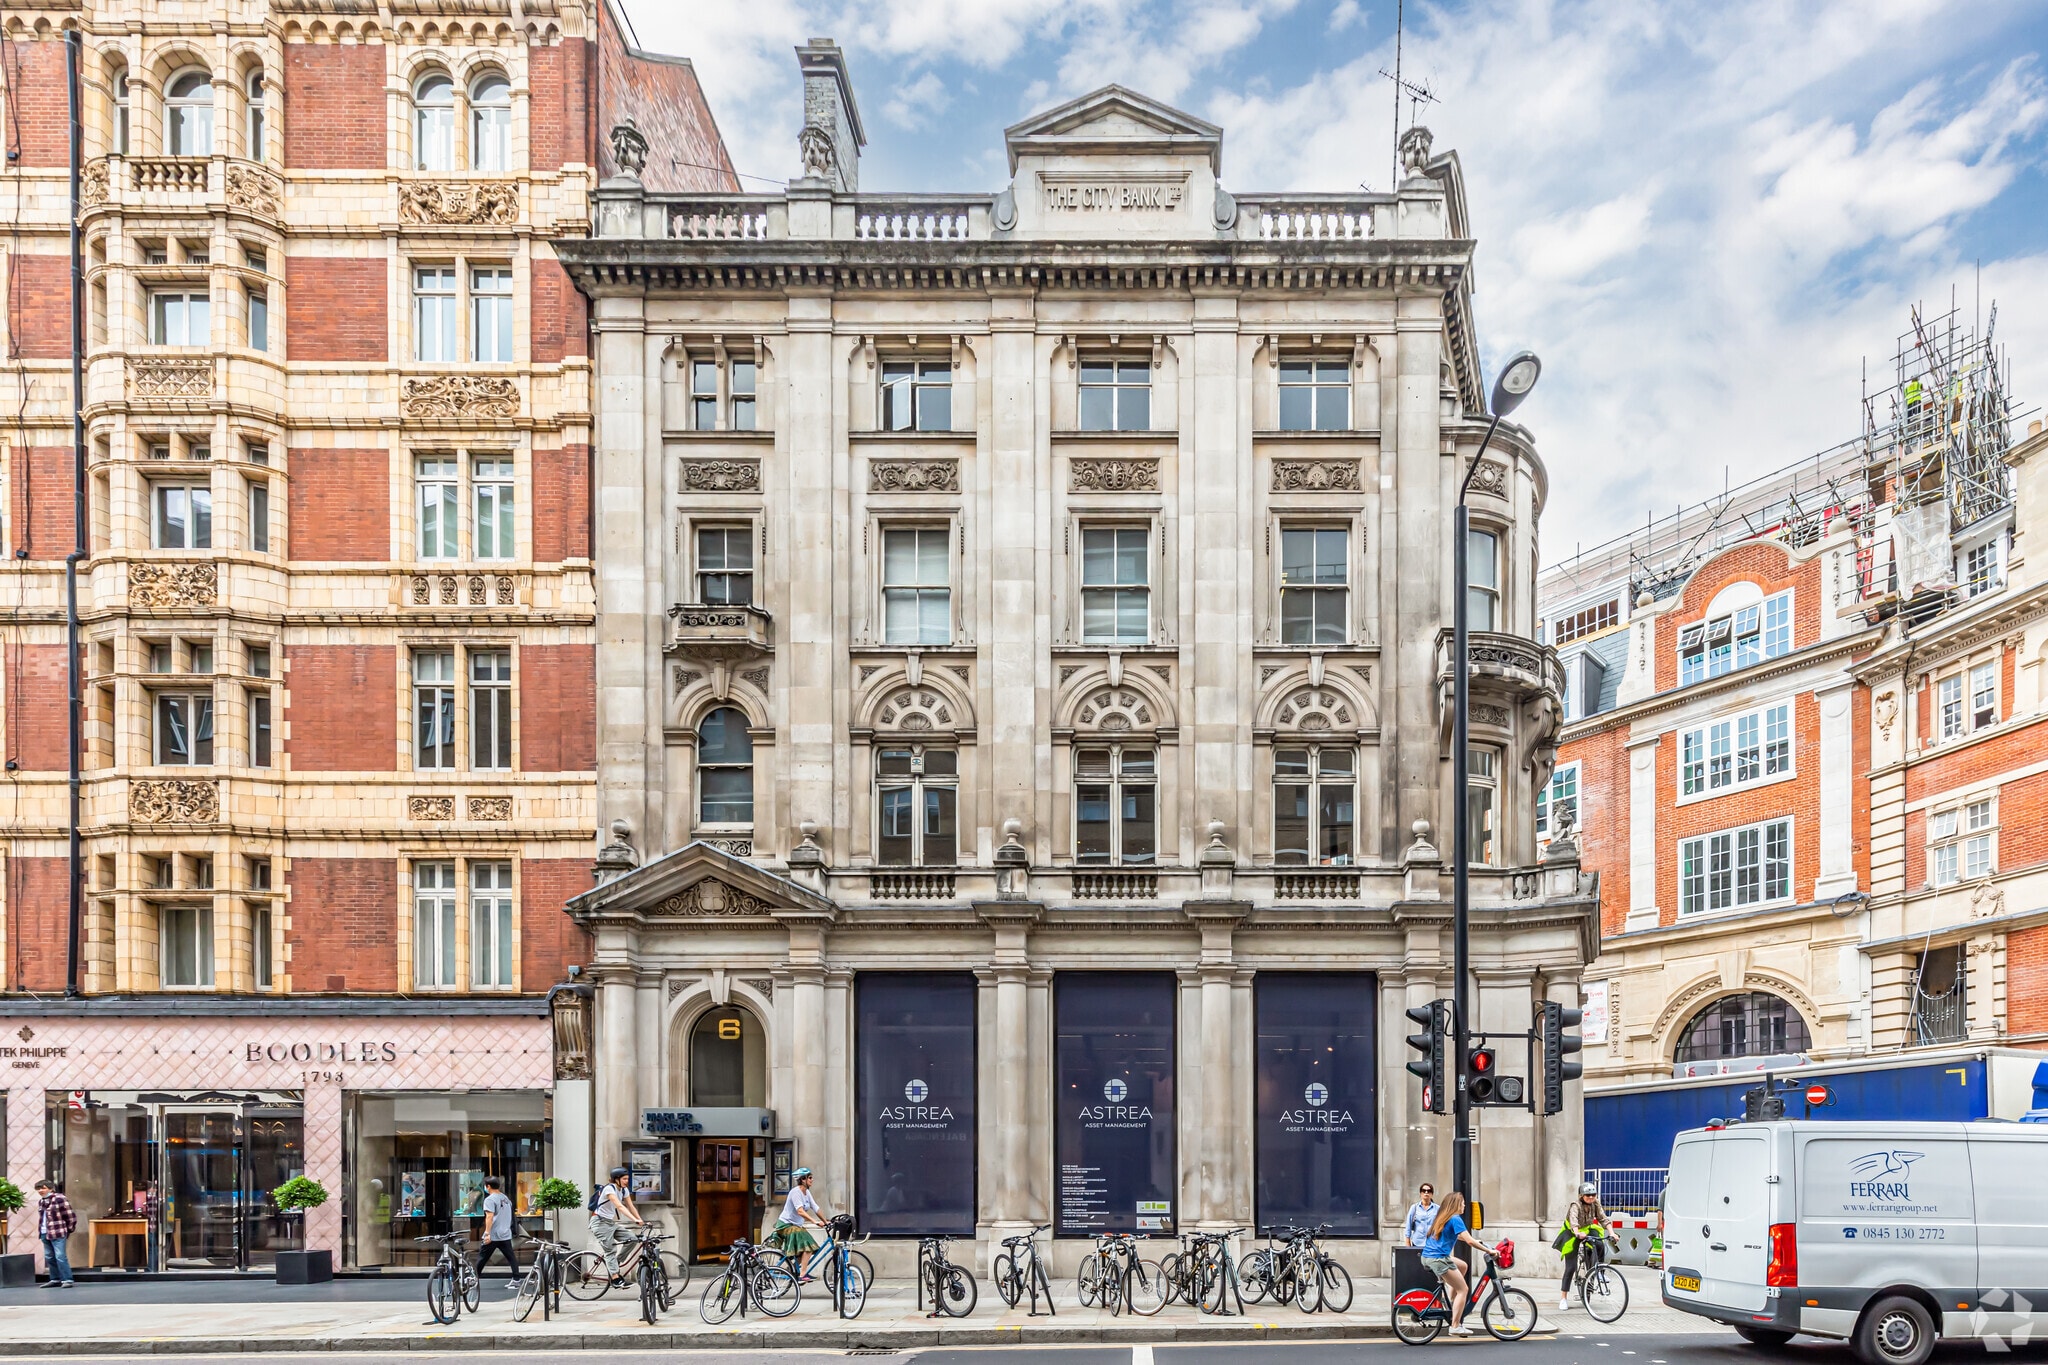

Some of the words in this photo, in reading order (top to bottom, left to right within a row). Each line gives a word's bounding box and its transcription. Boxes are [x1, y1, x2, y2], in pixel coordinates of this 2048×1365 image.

[1047, 188, 1077, 210] THE
[1082, 188, 1116, 210] CITY
[1120, 188, 1160, 210] BANK
[719, 1019, 740, 1039] 6
[20, 1047, 67, 1057] PHILIPPE
[246, 1042, 397, 1063] BOODLES
[301, 1071, 344, 1083] 1798
[879, 1106, 955, 1120] ASTREA
[1078, 1106, 1154, 1120] ASTREA
[1279, 1109, 1354, 1124] ASTREA
[1850, 1182, 1912, 1201] FERRARI
[1843, 1202, 1938, 1215] www.ferrarigroup.net
[1863, 1227, 1890, 1239] 0845
[1895, 1227, 1915, 1239] 130
[1919, 1228, 1945, 1240] 2772
